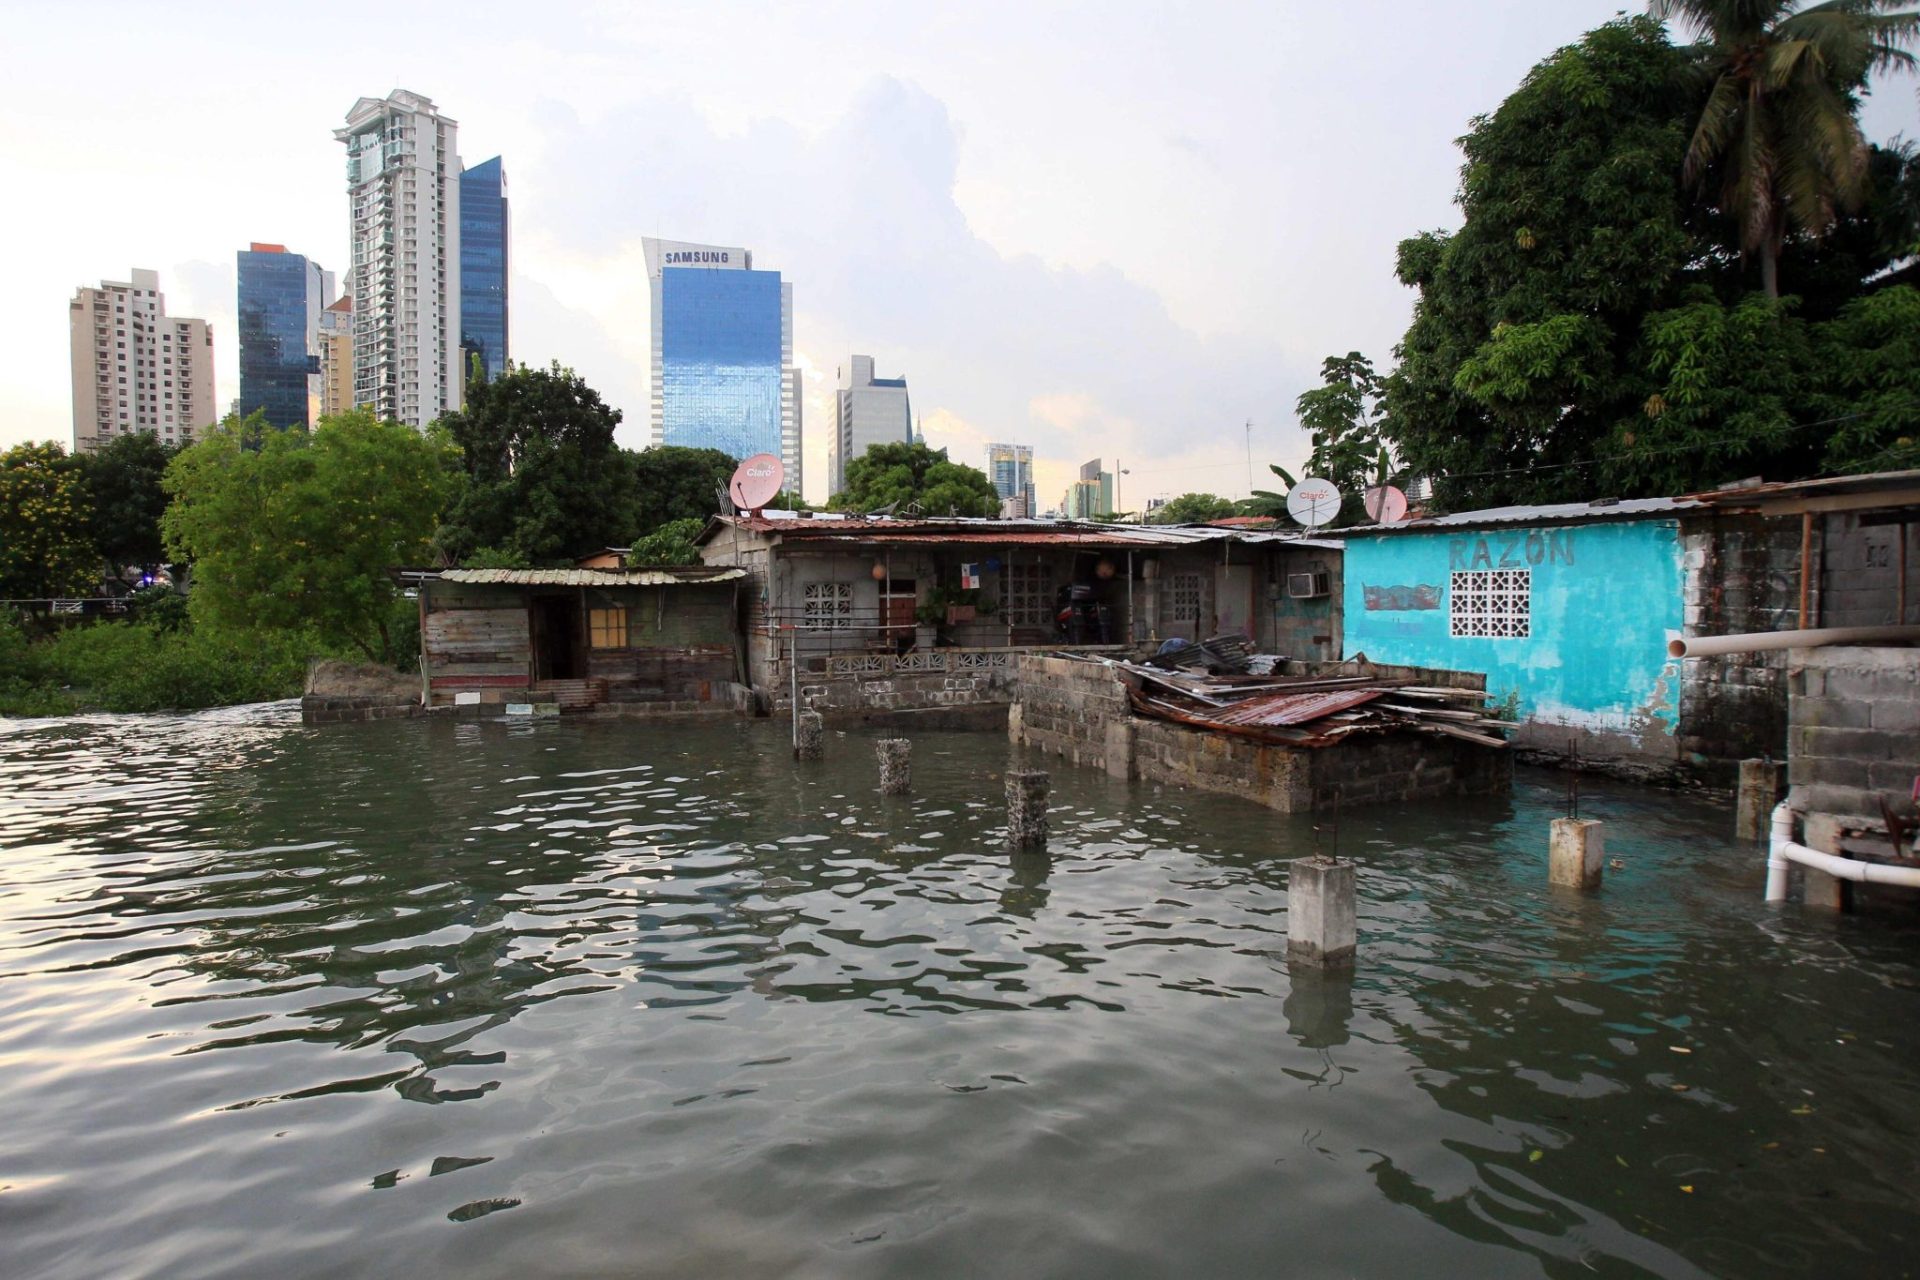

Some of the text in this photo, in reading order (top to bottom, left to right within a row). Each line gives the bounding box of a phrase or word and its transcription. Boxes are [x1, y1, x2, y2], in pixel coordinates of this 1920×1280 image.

[665, 251, 729, 264] SAMSUNG
[746, 467, 772, 477] Claro
[1299, 491, 1325, 500] Claro
